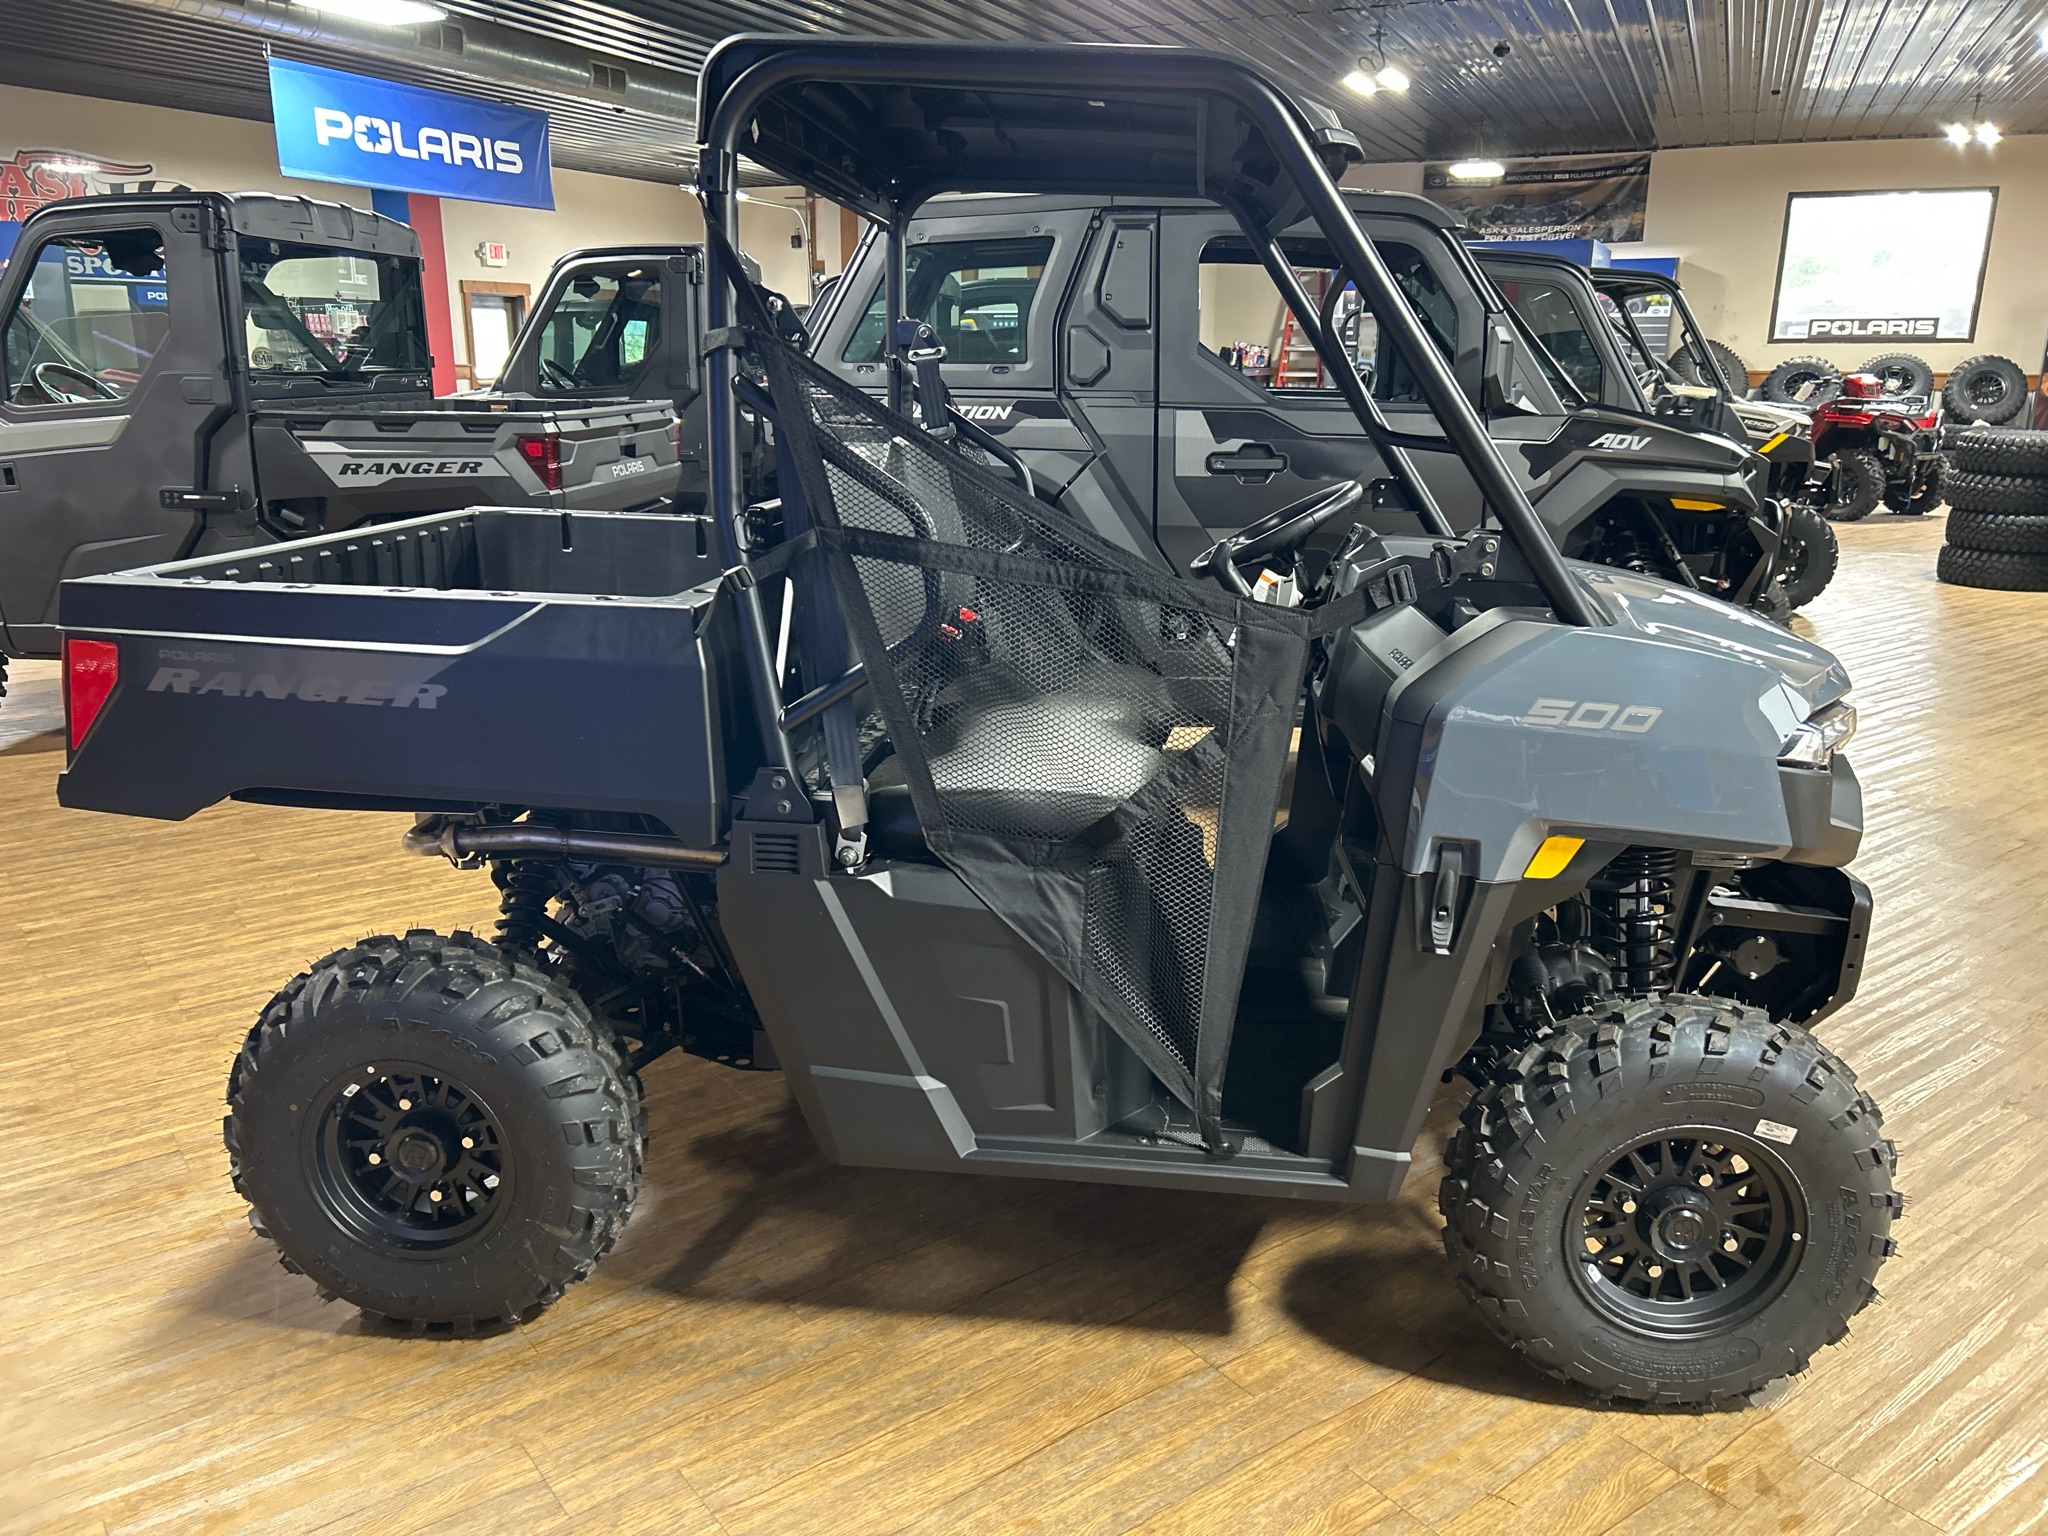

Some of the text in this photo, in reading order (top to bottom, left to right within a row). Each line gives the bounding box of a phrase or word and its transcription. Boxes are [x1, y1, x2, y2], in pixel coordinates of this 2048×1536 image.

[314, 107, 523, 175] POLARIS
[1505, 174, 1541, 182] ANNOUNCING
[1570, 171, 1593, 179] POLARIS
[1510, 224, 1581, 234] SALESPERSON
[1515, 233, 1537, 241] TEST
[1540, 232, 1575, 241] DRIVE!
[489, 244, 503, 260] EXIT
[1811, 320, 1935, 336] POLARIS
[1744, 419, 1777, 429] 1000
[1588, 433, 1653, 450] ADV
[338, 462, 483, 475] RANGER
[611, 461, 645, 477] POLARIS
[158, 649, 235, 664] POLARIS
[146, 667, 448, 709] RANGER
[1521, 697, 1663, 733] 500
[1517, 1163, 1557, 1292] CARLSTAR
